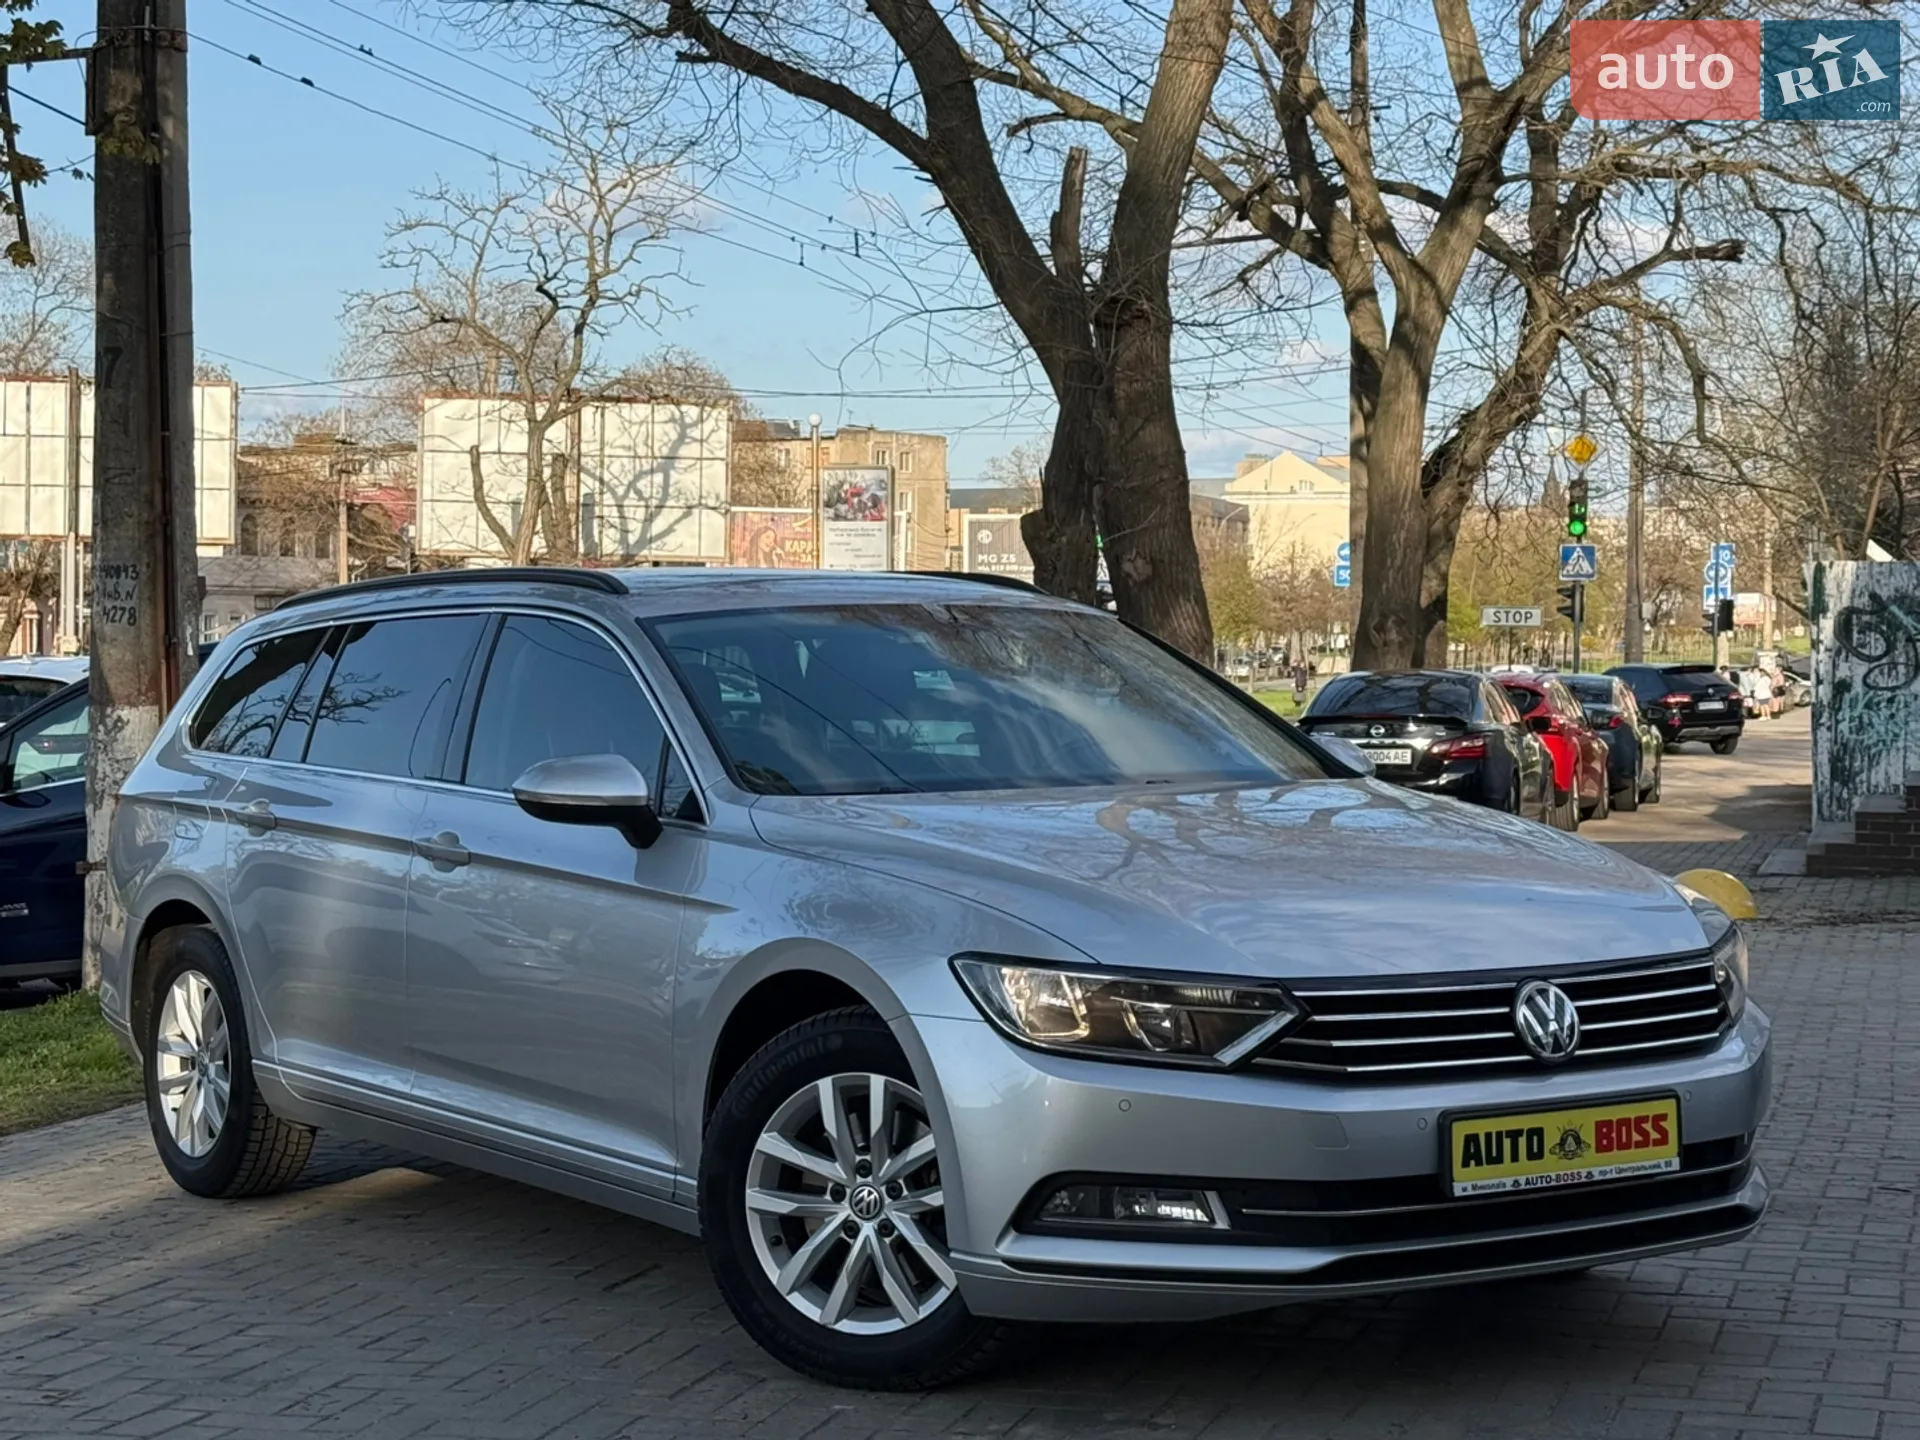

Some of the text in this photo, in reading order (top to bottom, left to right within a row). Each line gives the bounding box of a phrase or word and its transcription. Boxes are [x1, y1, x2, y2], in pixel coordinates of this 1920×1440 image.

[978, 554, 998, 564] MG
[103, 605, 137, 626] 4278
[1493, 610, 1533, 624] STOP
[1461, 1112, 1669, 1169] AUTO BOSS
[1524, 1171, 1583, 1188] AUTO-BOSS
